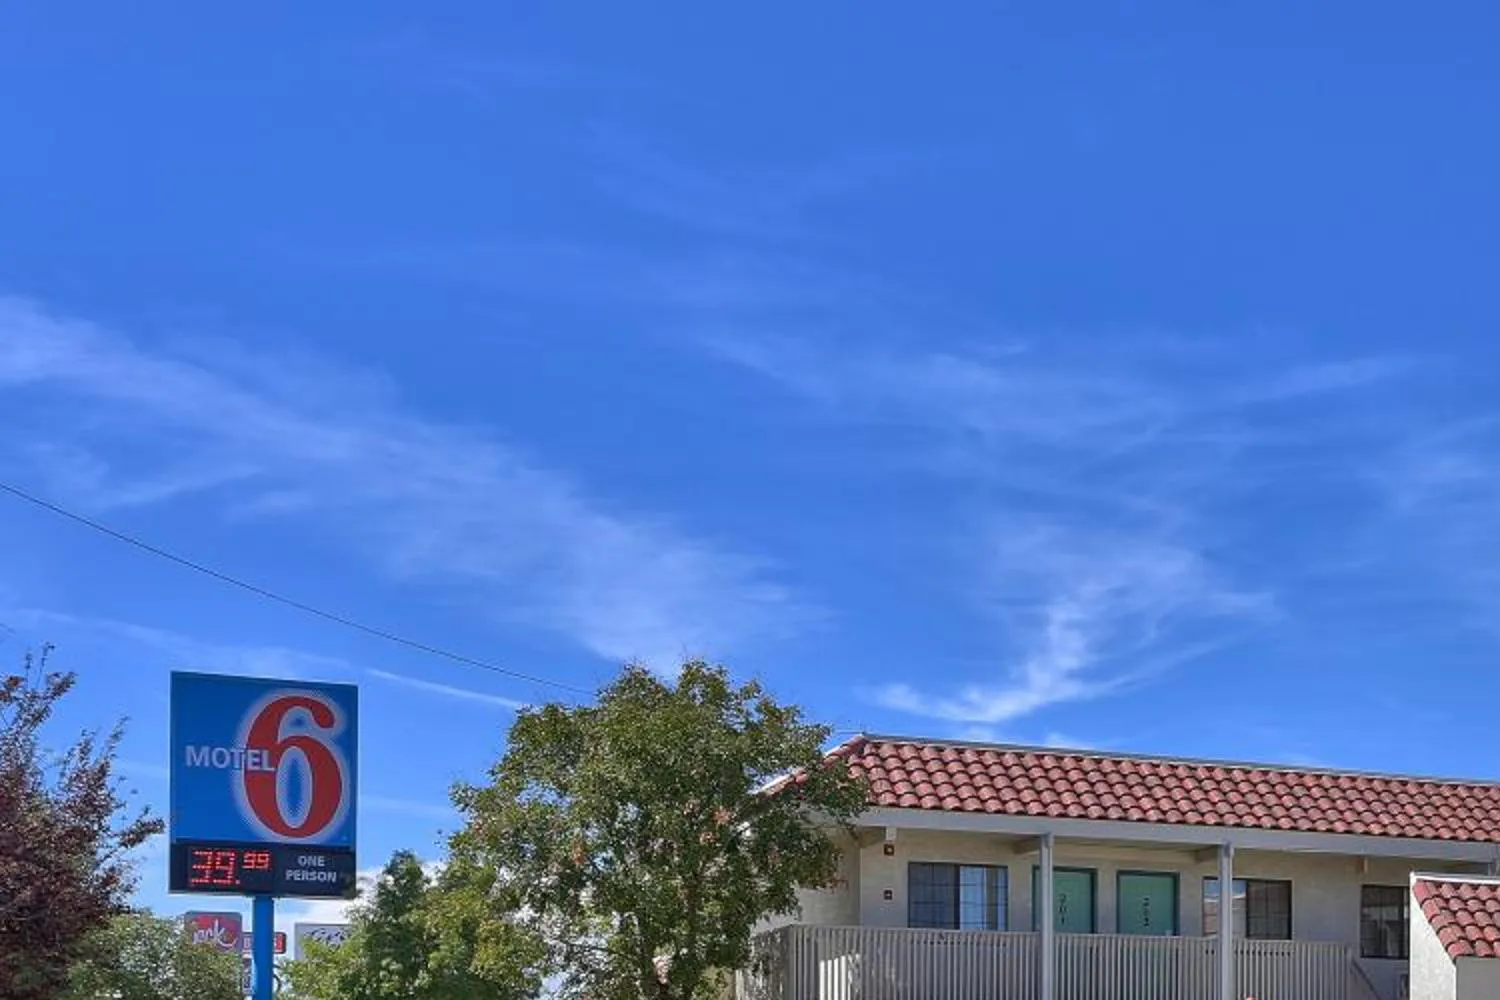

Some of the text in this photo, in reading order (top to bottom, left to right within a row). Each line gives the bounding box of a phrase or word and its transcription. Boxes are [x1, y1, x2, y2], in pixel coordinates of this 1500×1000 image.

[185, 695, 342, 838] MOTEL 6
[298, 855, 325, 867] ONE
[286, 870, 337, 883] PERSON
